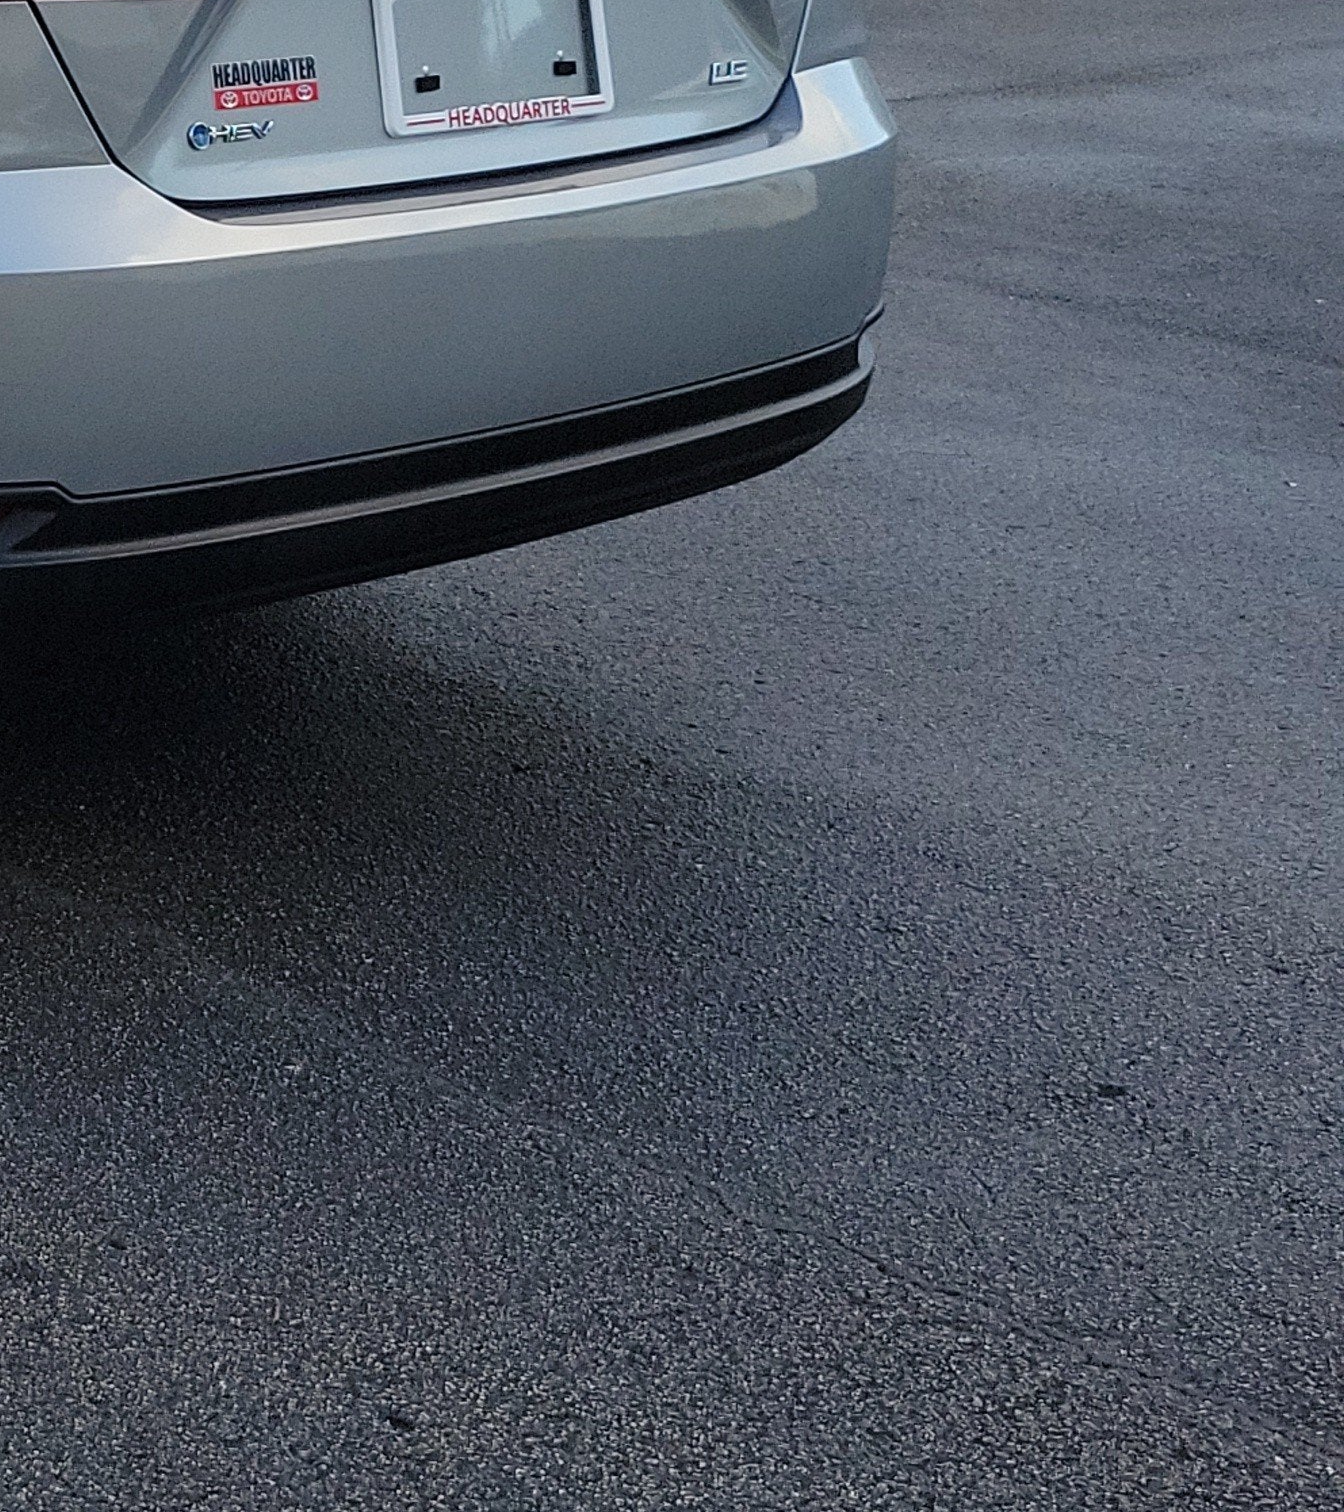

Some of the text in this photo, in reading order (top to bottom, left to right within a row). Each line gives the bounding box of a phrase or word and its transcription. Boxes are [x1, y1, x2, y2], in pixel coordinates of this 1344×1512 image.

[212, 55, 317, 89] HEADQUARTER
[709, 59, 748, 86] LE
[241, 88, 293, 106] TOYOTA
[448, 98, 572, 129] HEADQUARTER
